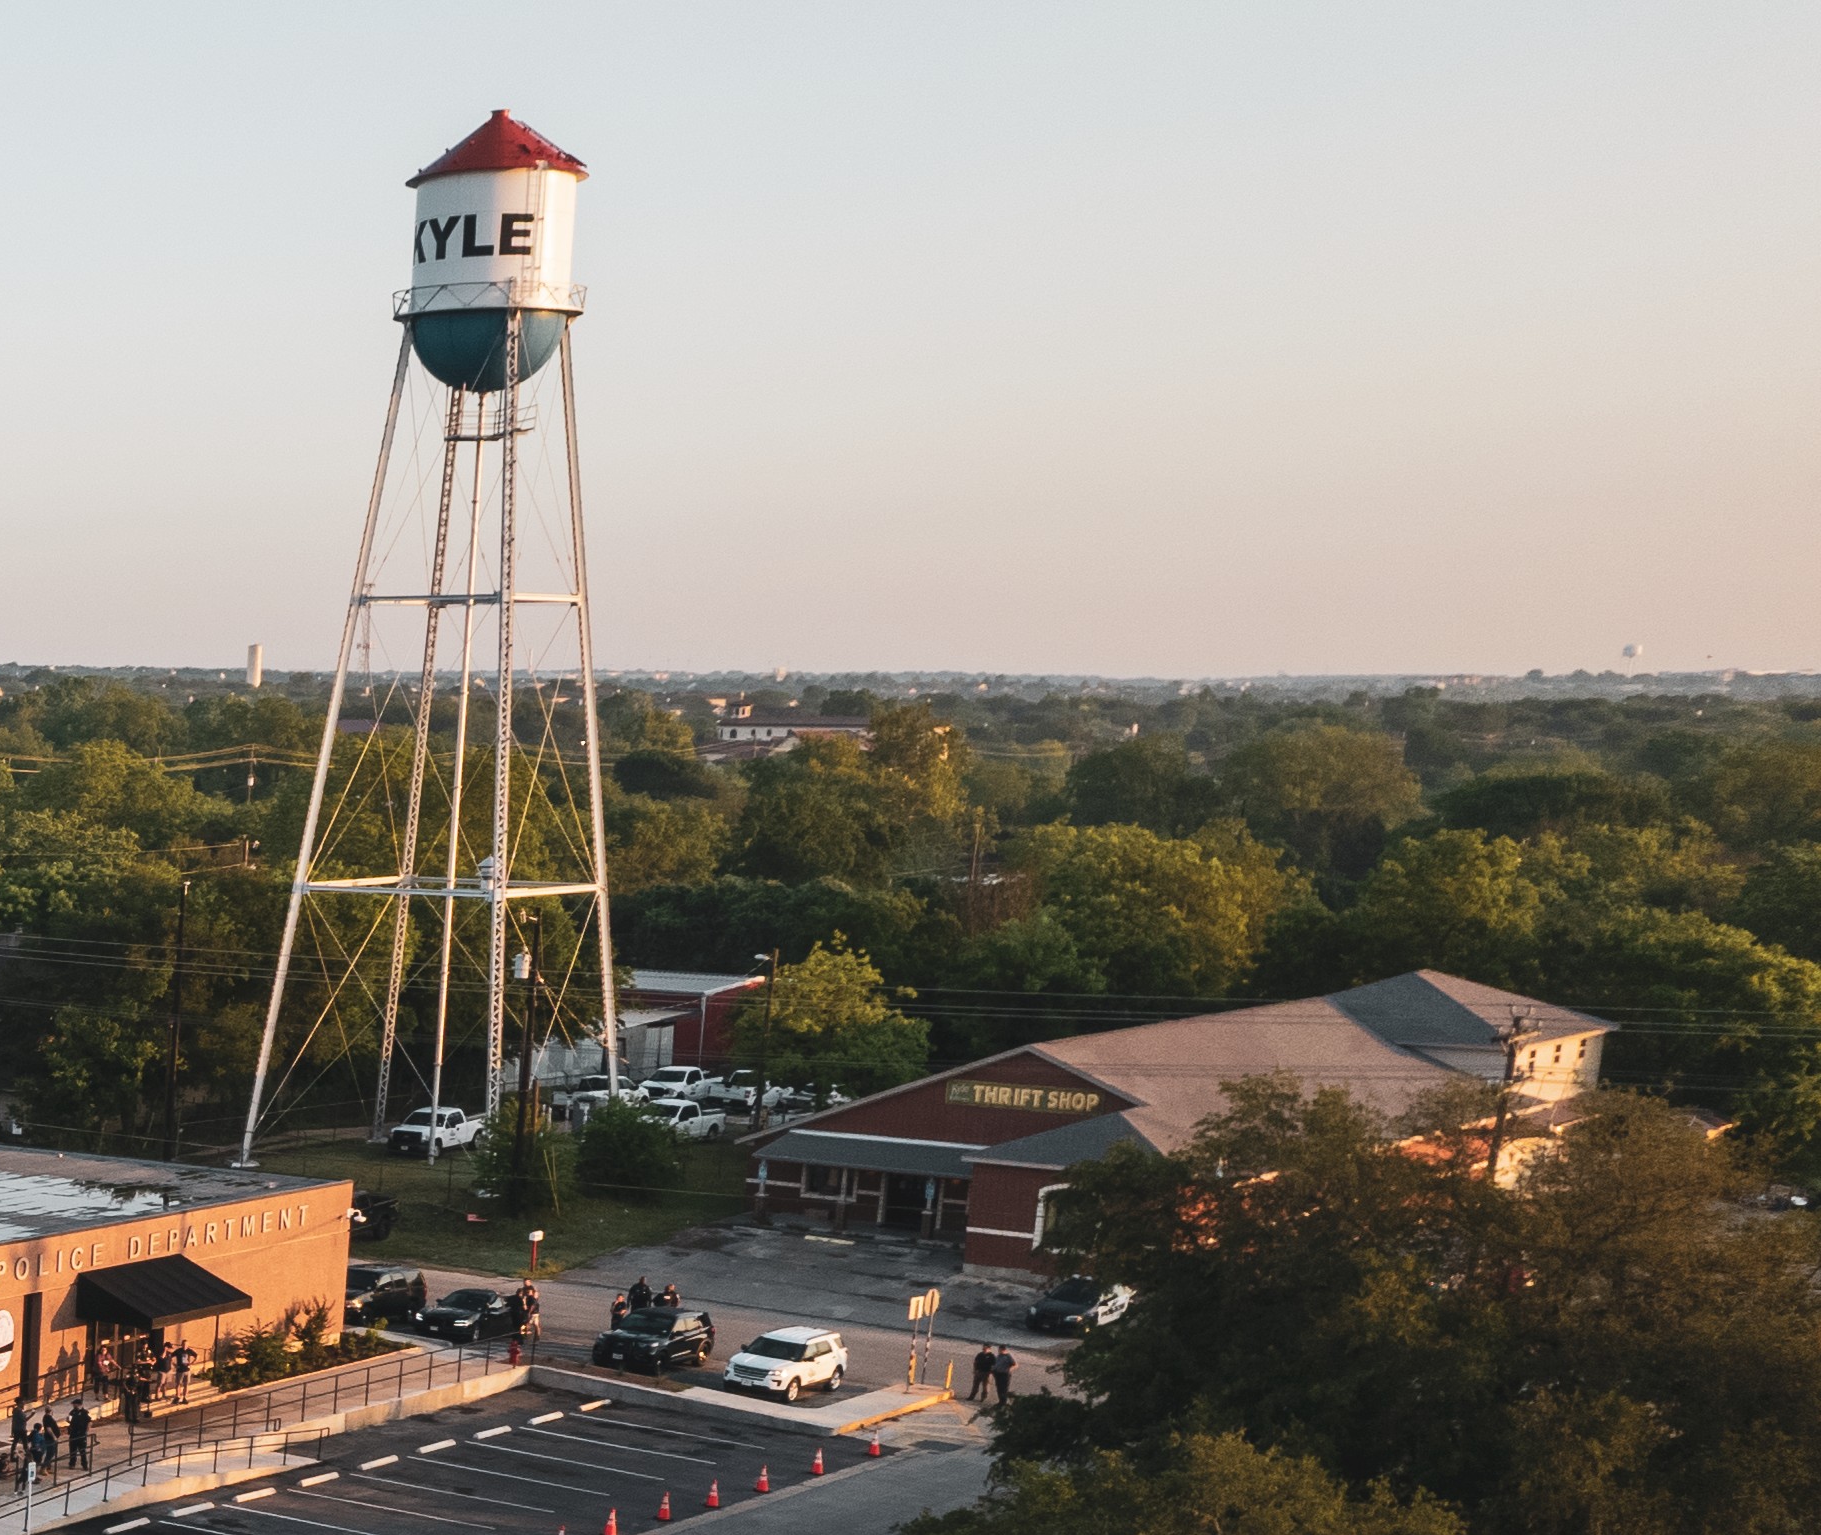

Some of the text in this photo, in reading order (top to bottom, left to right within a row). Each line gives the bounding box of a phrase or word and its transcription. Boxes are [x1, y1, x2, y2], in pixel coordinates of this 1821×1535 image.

[413, 212, 535, 265] KYLE
[973, 1085, 1044, 1107] THRIFT
[1047, 1090, 1100, 1112] SHOP
[128, 1205, 311, 1260] DEPARTMENT
